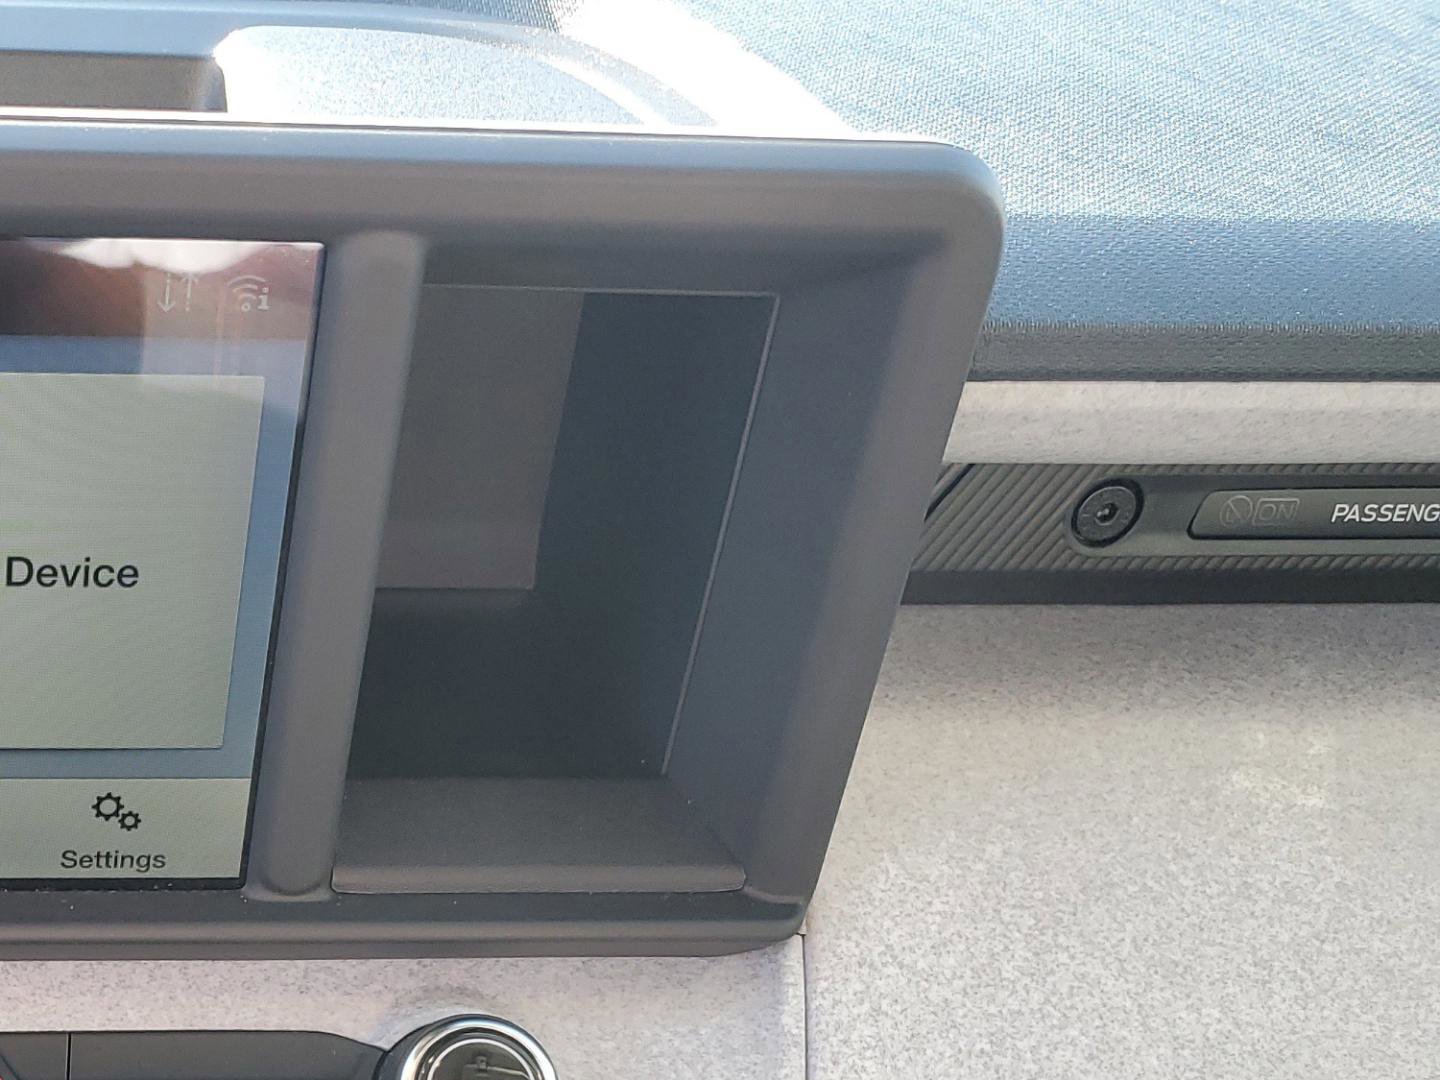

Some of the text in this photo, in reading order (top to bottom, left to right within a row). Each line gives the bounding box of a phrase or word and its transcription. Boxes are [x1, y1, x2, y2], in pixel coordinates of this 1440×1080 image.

[1330, 503, 1440, 523] PASSENG
[6, 556, 140, 588] Device
[60, 849, 167, 873] Settings
